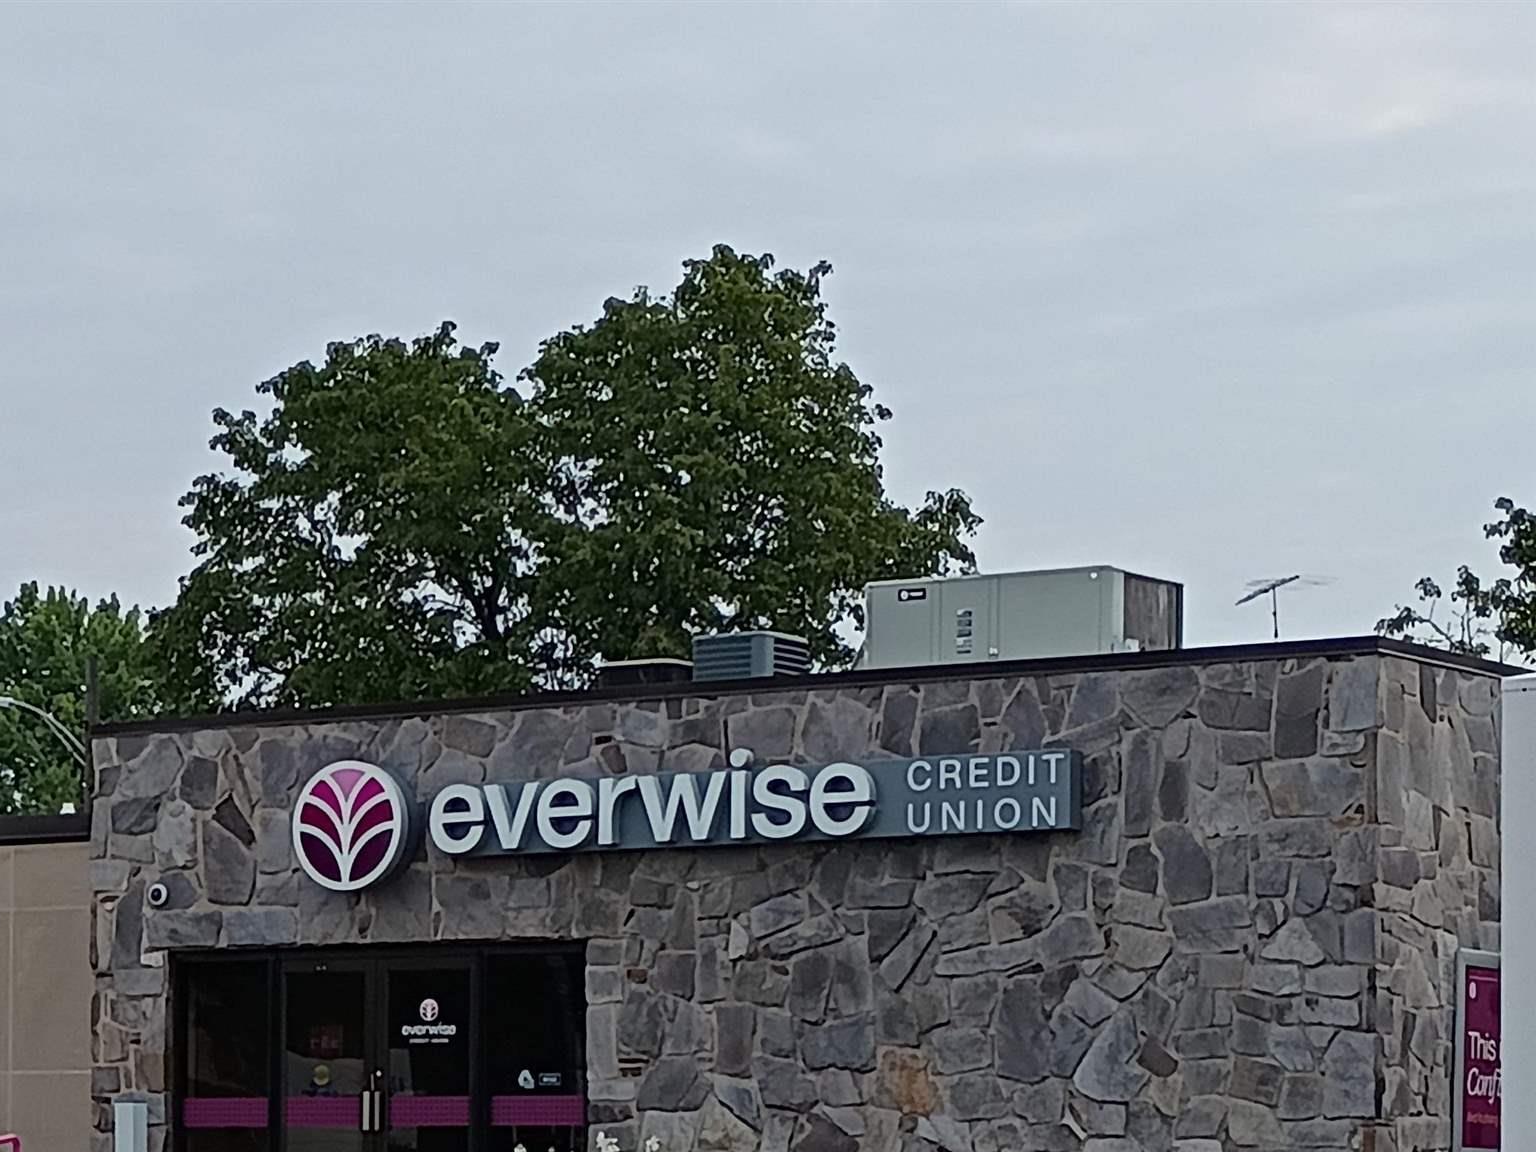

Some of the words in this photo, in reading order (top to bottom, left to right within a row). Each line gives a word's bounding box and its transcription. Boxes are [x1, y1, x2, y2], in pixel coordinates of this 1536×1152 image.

[907, 753, 1065, 791] CREDIT
[429, 748, 874, 854] everwise
[907, 796, 1057, 834] UNION
[1467, 1031, 1497, 1062] This
